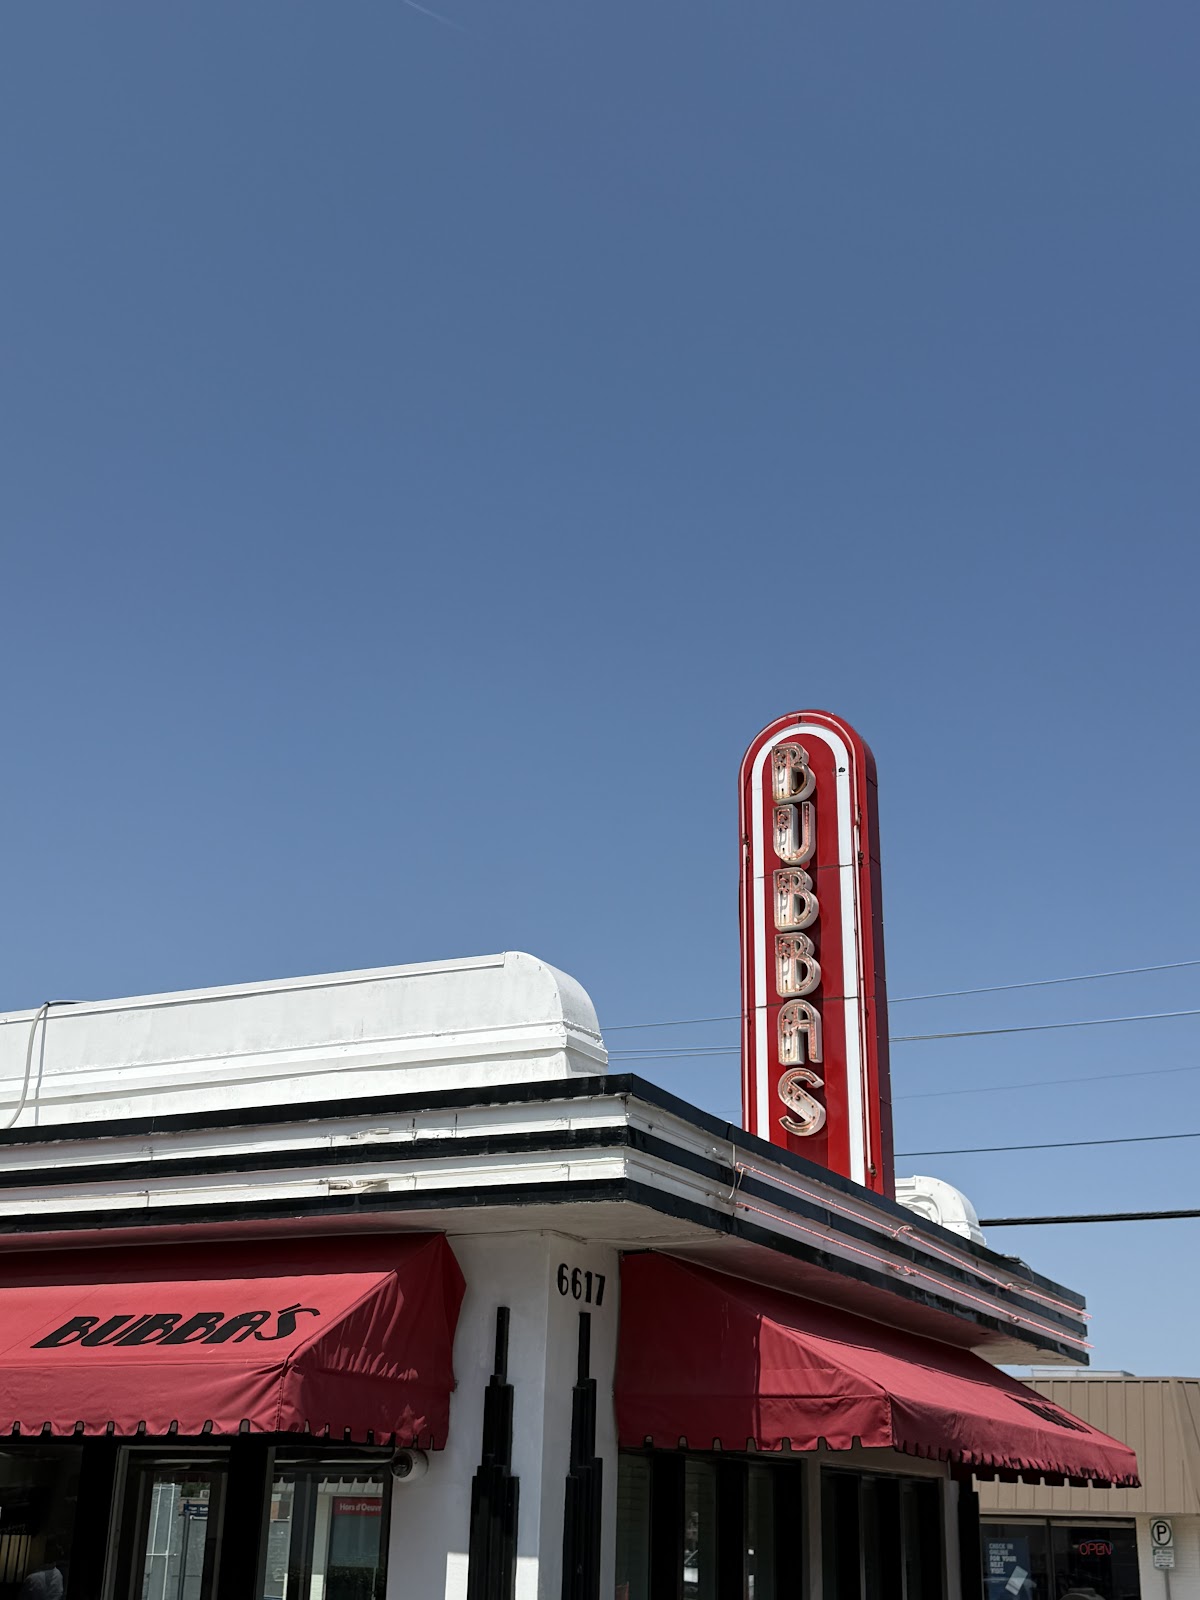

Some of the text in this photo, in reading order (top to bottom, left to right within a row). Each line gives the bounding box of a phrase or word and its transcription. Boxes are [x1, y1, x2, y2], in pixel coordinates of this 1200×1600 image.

[771, 741, 827, 1137] BUBBAS
[557, 1262, 606, 1307] 6617
[340, 1503, 354, 1511] Hors
[1157, 1525, 1167, 1541] P
[1080, 1542, 1112, 1555] OPEN
